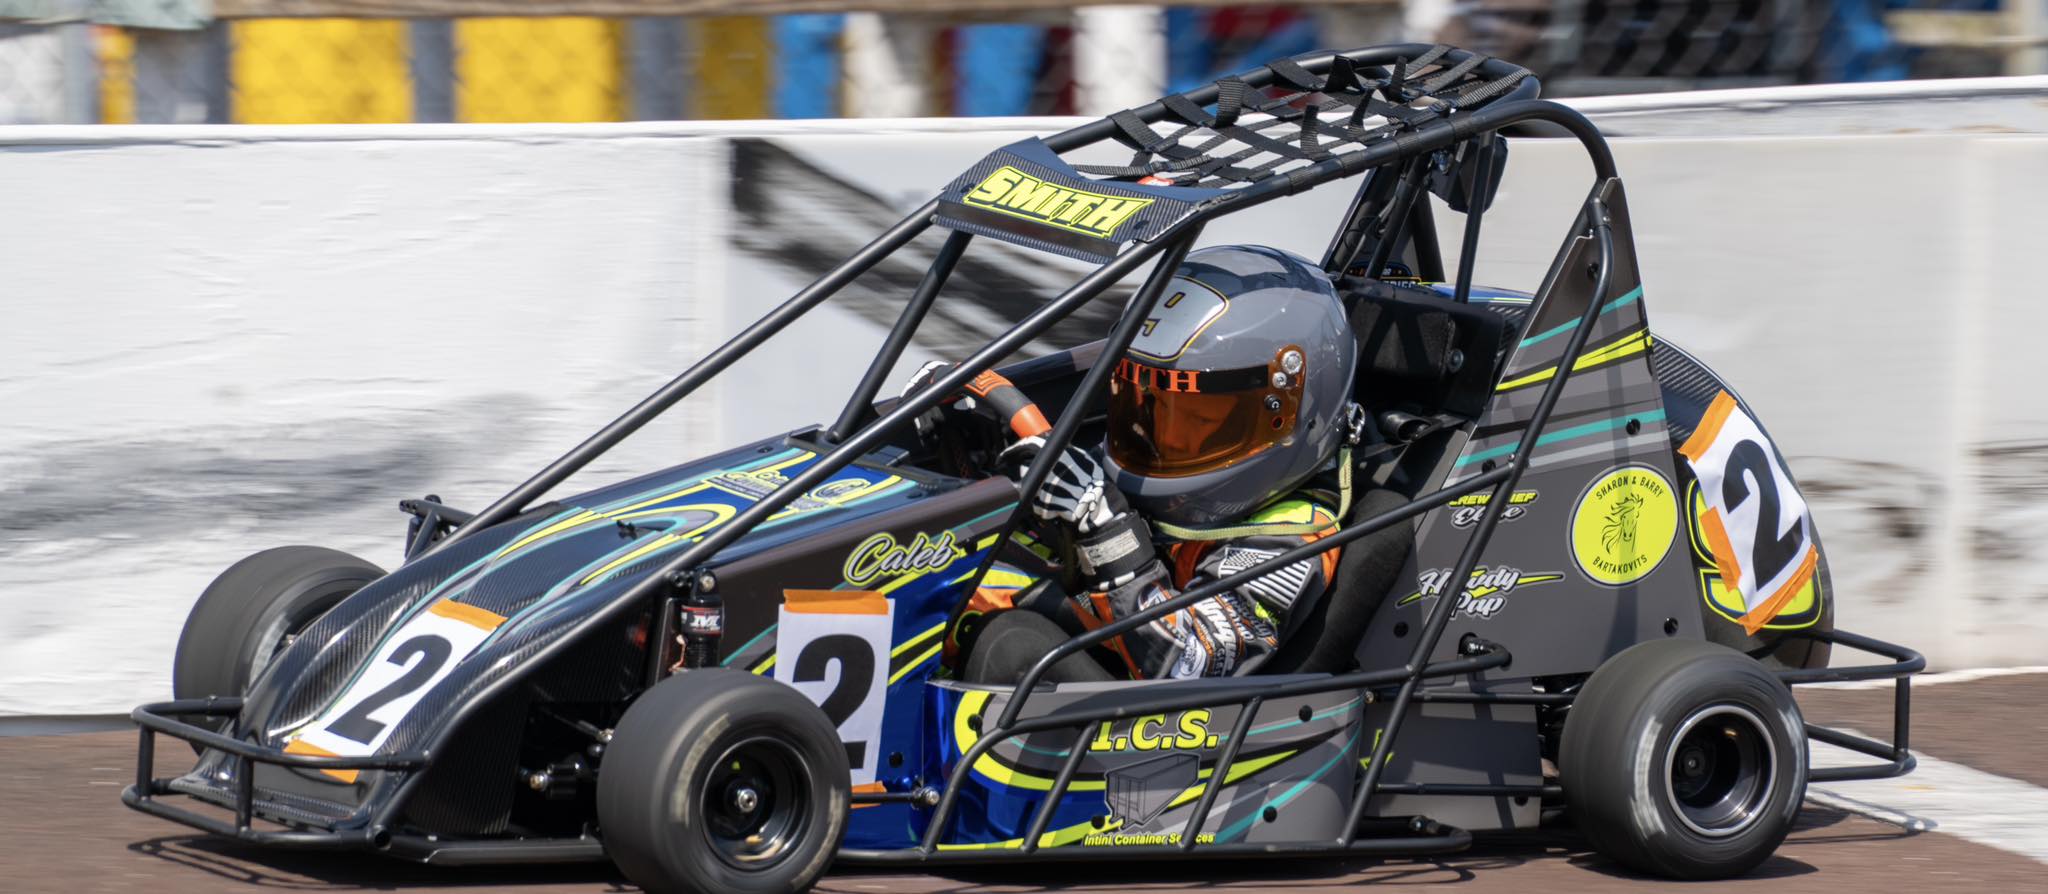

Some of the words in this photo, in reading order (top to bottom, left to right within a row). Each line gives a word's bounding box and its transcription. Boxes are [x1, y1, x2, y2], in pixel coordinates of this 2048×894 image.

[971, 167, 1146, 232] SMITH
[1115, 358, 1201, 392] MITH
[1596, 476, 1628, 500] SHARON
[1631, 476, 1637, 485] &
[1639, 476, 1664, 497] BARRY
[1722, 439, 1804, 592] 2
[847, 530, 955, 582] Caleb
[1593, 554, 1648, 574] BARTAKOVITS
[325, 633, 453, 746] 2
[793, 634, 875, 769] 2
[1084, 835, 1113, 846] Intini
[1114, 833, 1167, 846] Container
